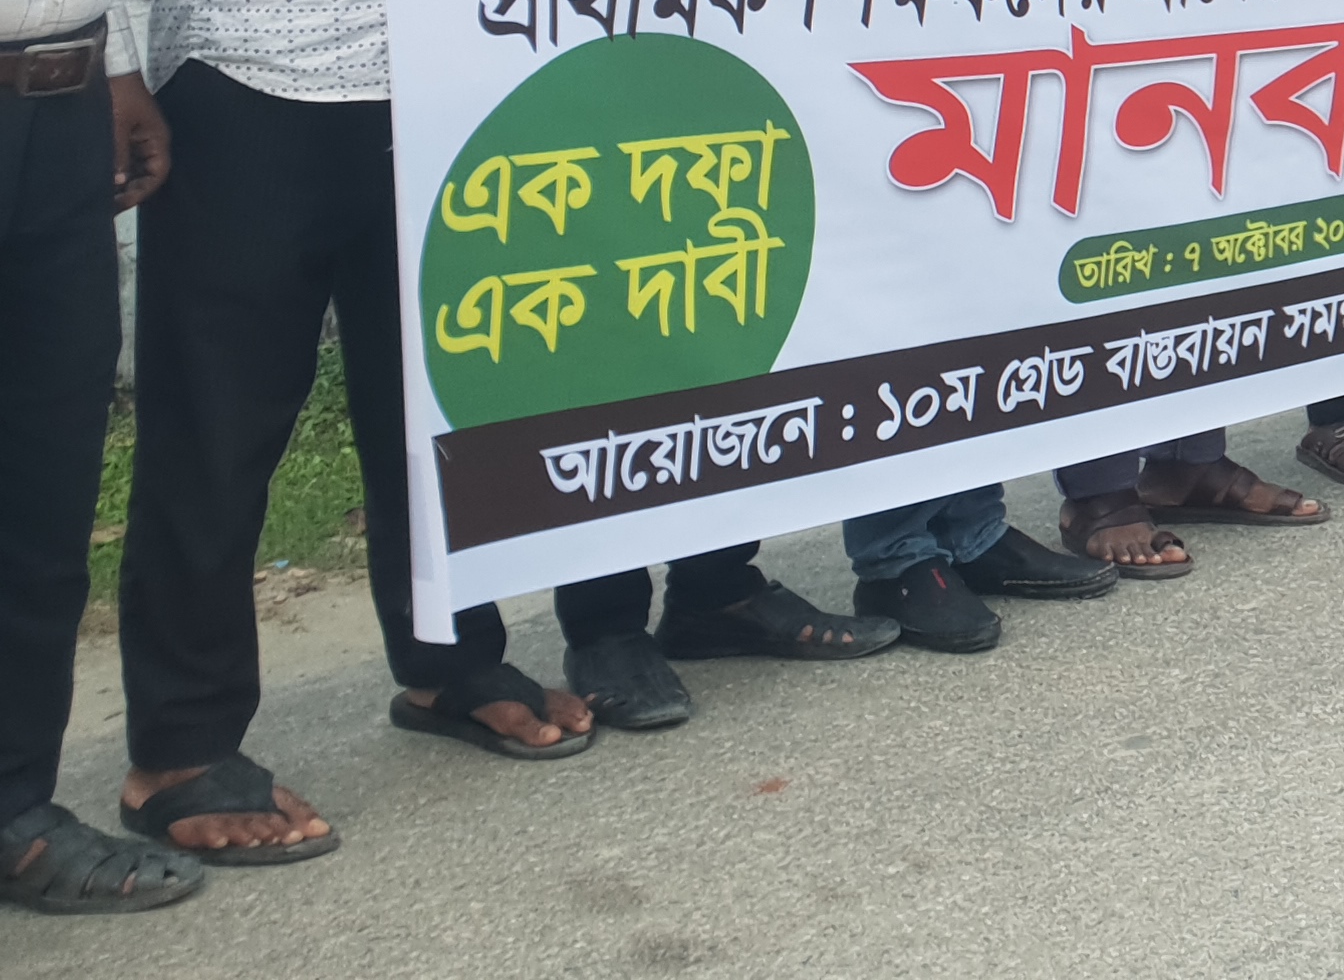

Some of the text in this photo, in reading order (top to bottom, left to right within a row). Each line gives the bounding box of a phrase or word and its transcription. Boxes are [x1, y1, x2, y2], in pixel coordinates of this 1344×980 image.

[441, 118, 790, 244] এক দফা
[435, 208, 785, 364] এক দাবী
[1073, 240, 1158, 289] তারিখ
[1184, 242, 1200, 272] ৭
[1210, 219, 1307, 266] অক্টোবর
[540, 397, 822, 503] আয়োজনে
[876, 367, 984, 442] ১০ম
[997, 346, 1094, 413] গ্রেড
[1104, 309, 1275, 391] বাস্তবায়ন
